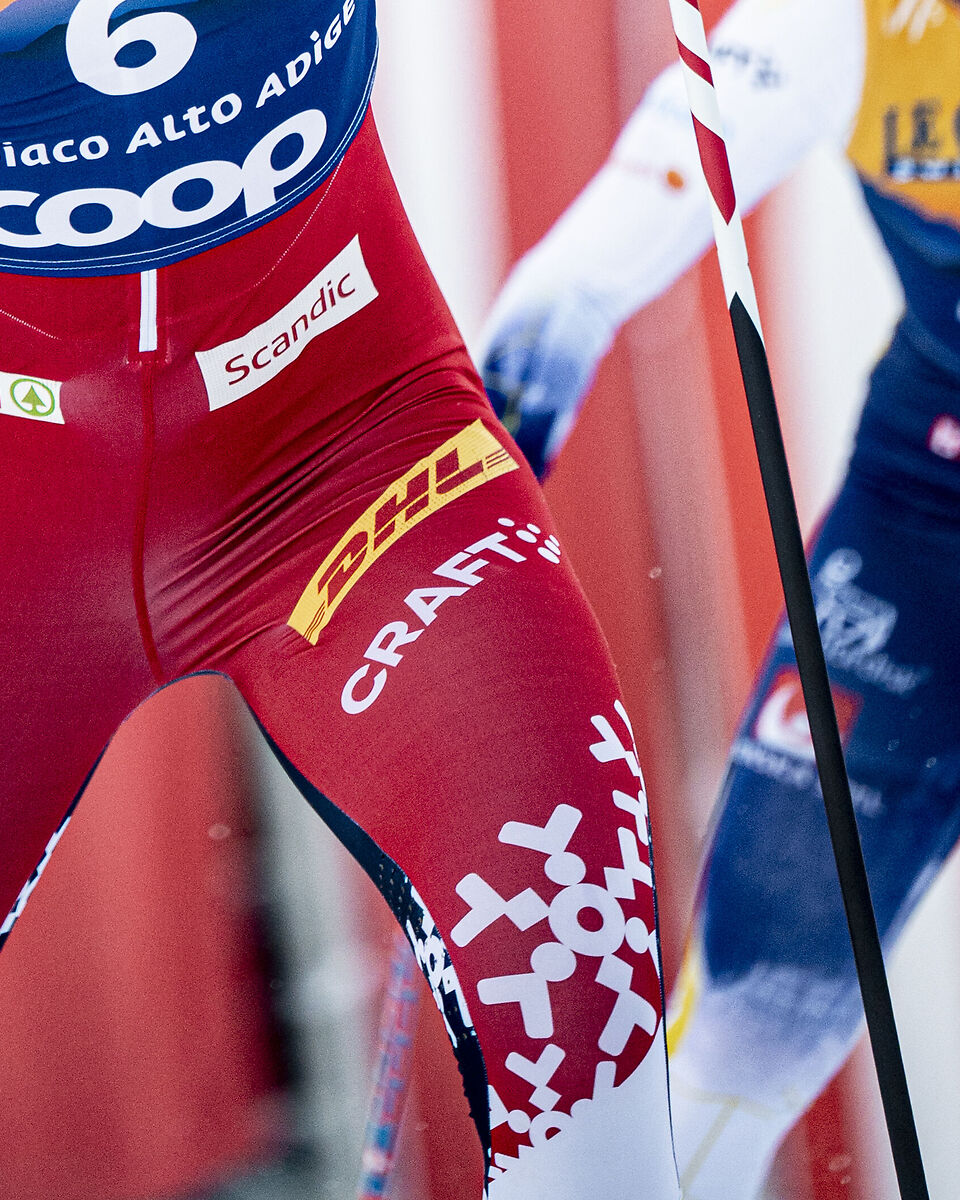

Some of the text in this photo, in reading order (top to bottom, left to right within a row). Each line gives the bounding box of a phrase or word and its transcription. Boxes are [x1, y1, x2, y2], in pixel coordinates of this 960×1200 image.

[225, 271, 356, 385] Scandic
[317, 448, 485, 608] DHL
[341, 532, 527, 715] CRAFT
